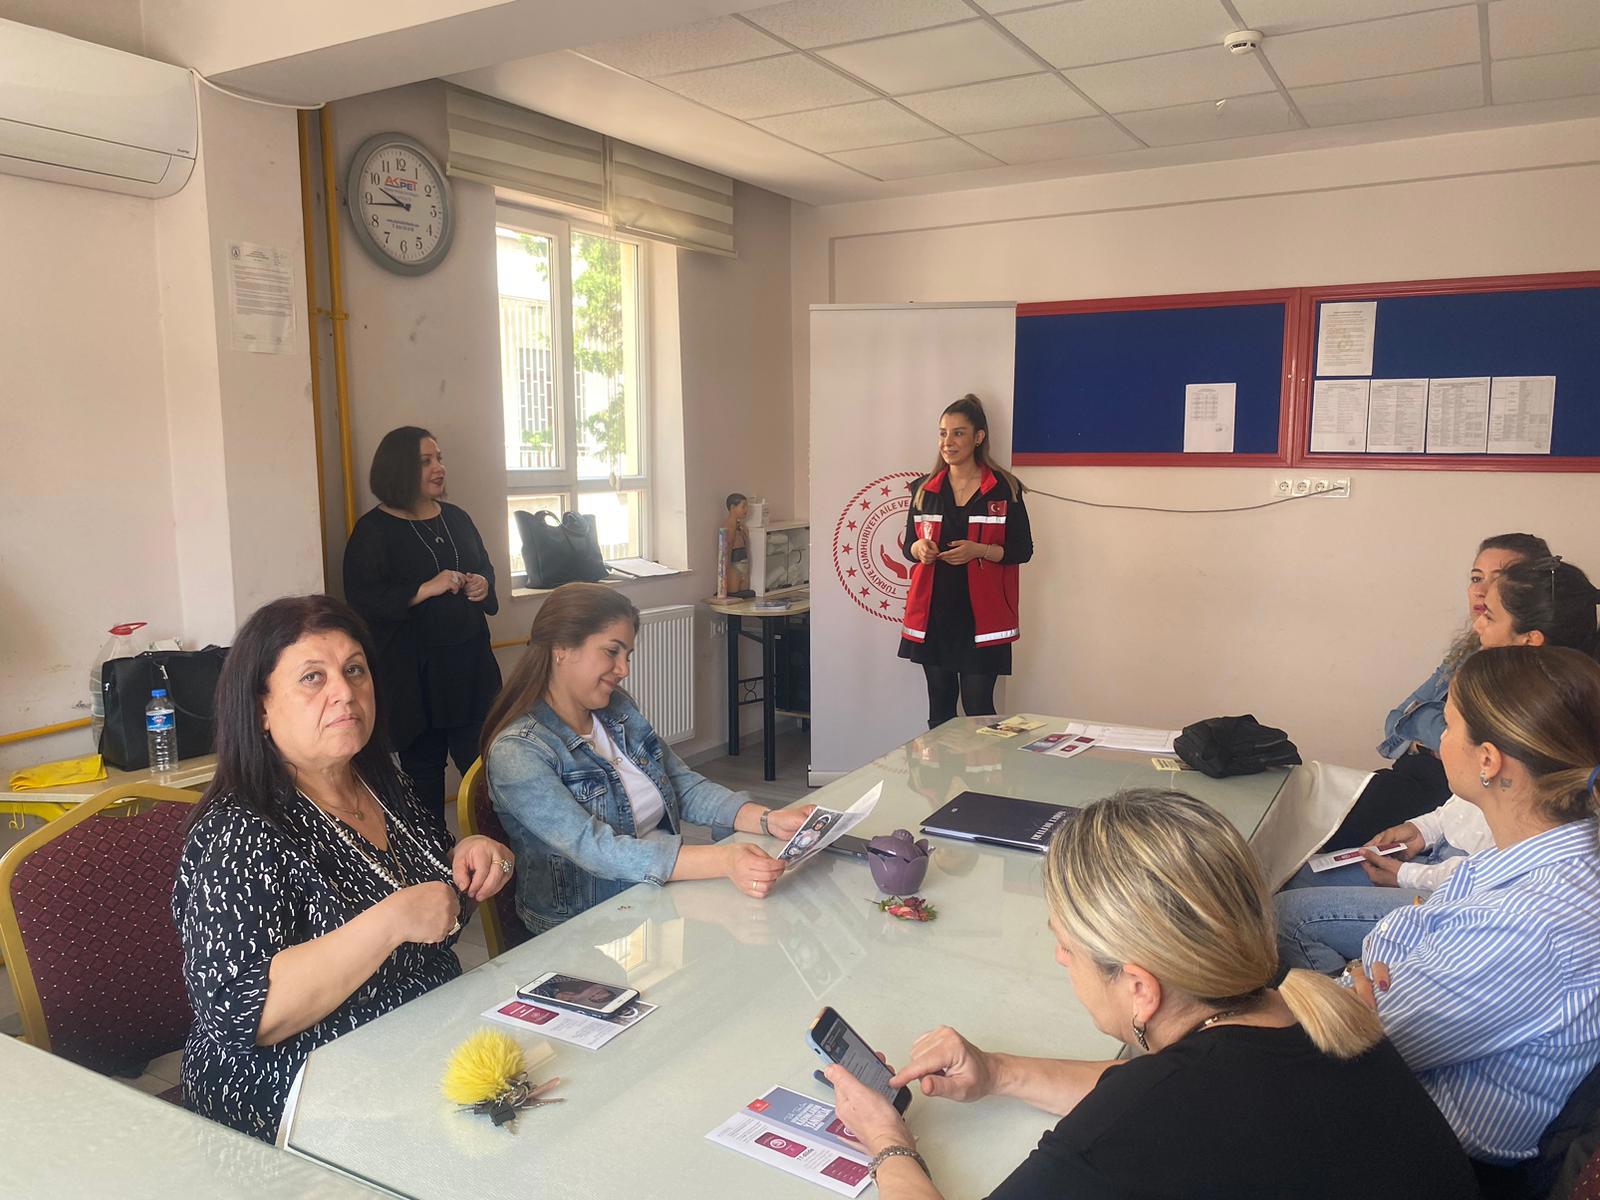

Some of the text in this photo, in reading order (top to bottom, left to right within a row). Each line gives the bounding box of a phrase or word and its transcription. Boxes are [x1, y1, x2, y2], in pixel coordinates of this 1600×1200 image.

[382, 160, 390, 173] 11
[396, 158, 406, 171] 12
[370, 172, 380, 185] 10
[384, 176, 418, 192] AKPET
[365, 192, 373, 204] 9
[424, 185, 432, 198] 2
[430, 205, 437, 218] 3
[371, 214, 379, 228] 8
[426, 224, 432, 237] 4
[384, 231, 391, 244] 7
[415, 236, 423, 250] 5
[400, 240, 408, 254] 6
[861, 500, 909, 595] TÜRKİYE CUMHURİYETİ AİLE VE
